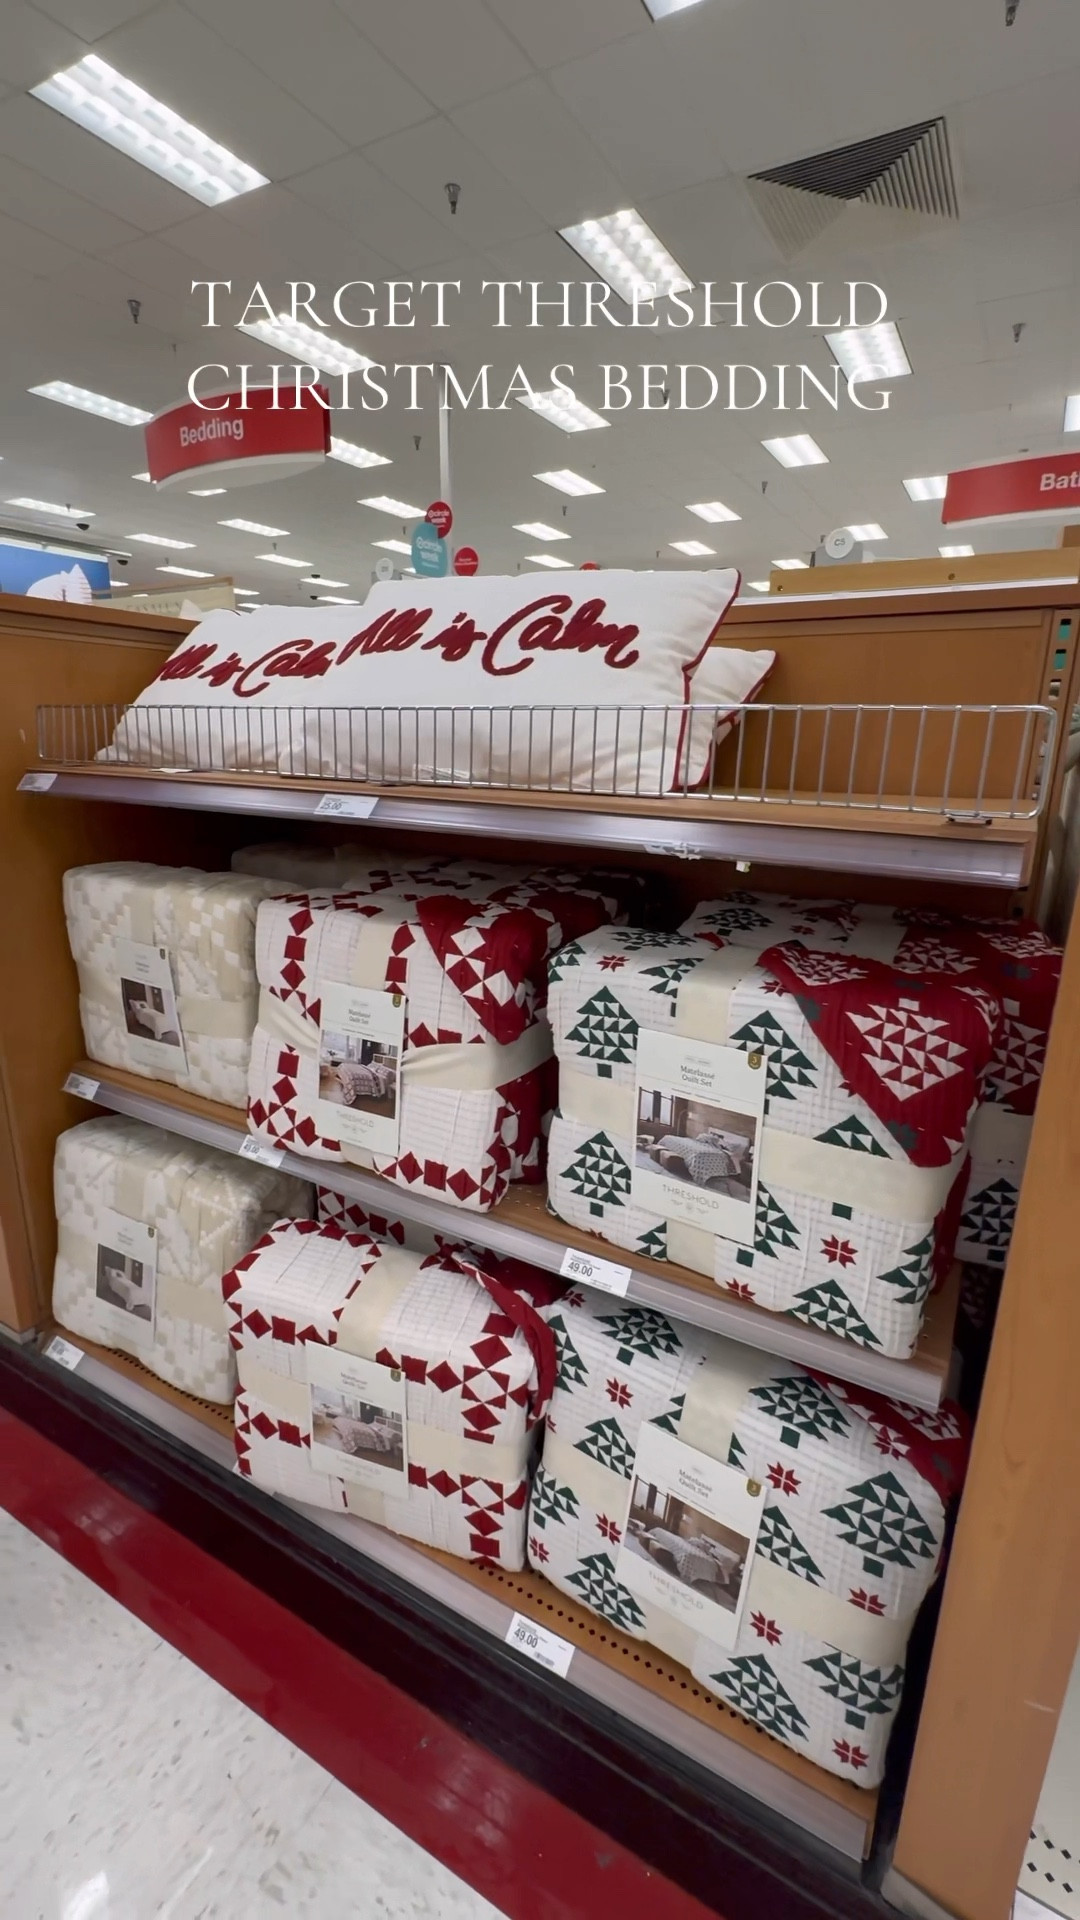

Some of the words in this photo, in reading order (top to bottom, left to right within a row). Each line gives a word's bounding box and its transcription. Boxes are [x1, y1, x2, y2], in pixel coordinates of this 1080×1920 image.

[179, 417, 244, 447] Bedding
[1040, 471, 1080, 491] Bat
[336, 608, 433, 665] All
[421, 612, 488, 662] is
[482, 595, 640, 676] Calm
[198, 652, 246, 688] is
[681, 1074, 699, 1085] Quilt
[700, 1079, 713, 1088] Set
[662, 1183, 720, 1210] THRESHOLD
[568, 1261, 593, 1277] 49.00
[679, 1478, 696, 1492] Quilt
[514, 1628, 538, 1648] 49.00
